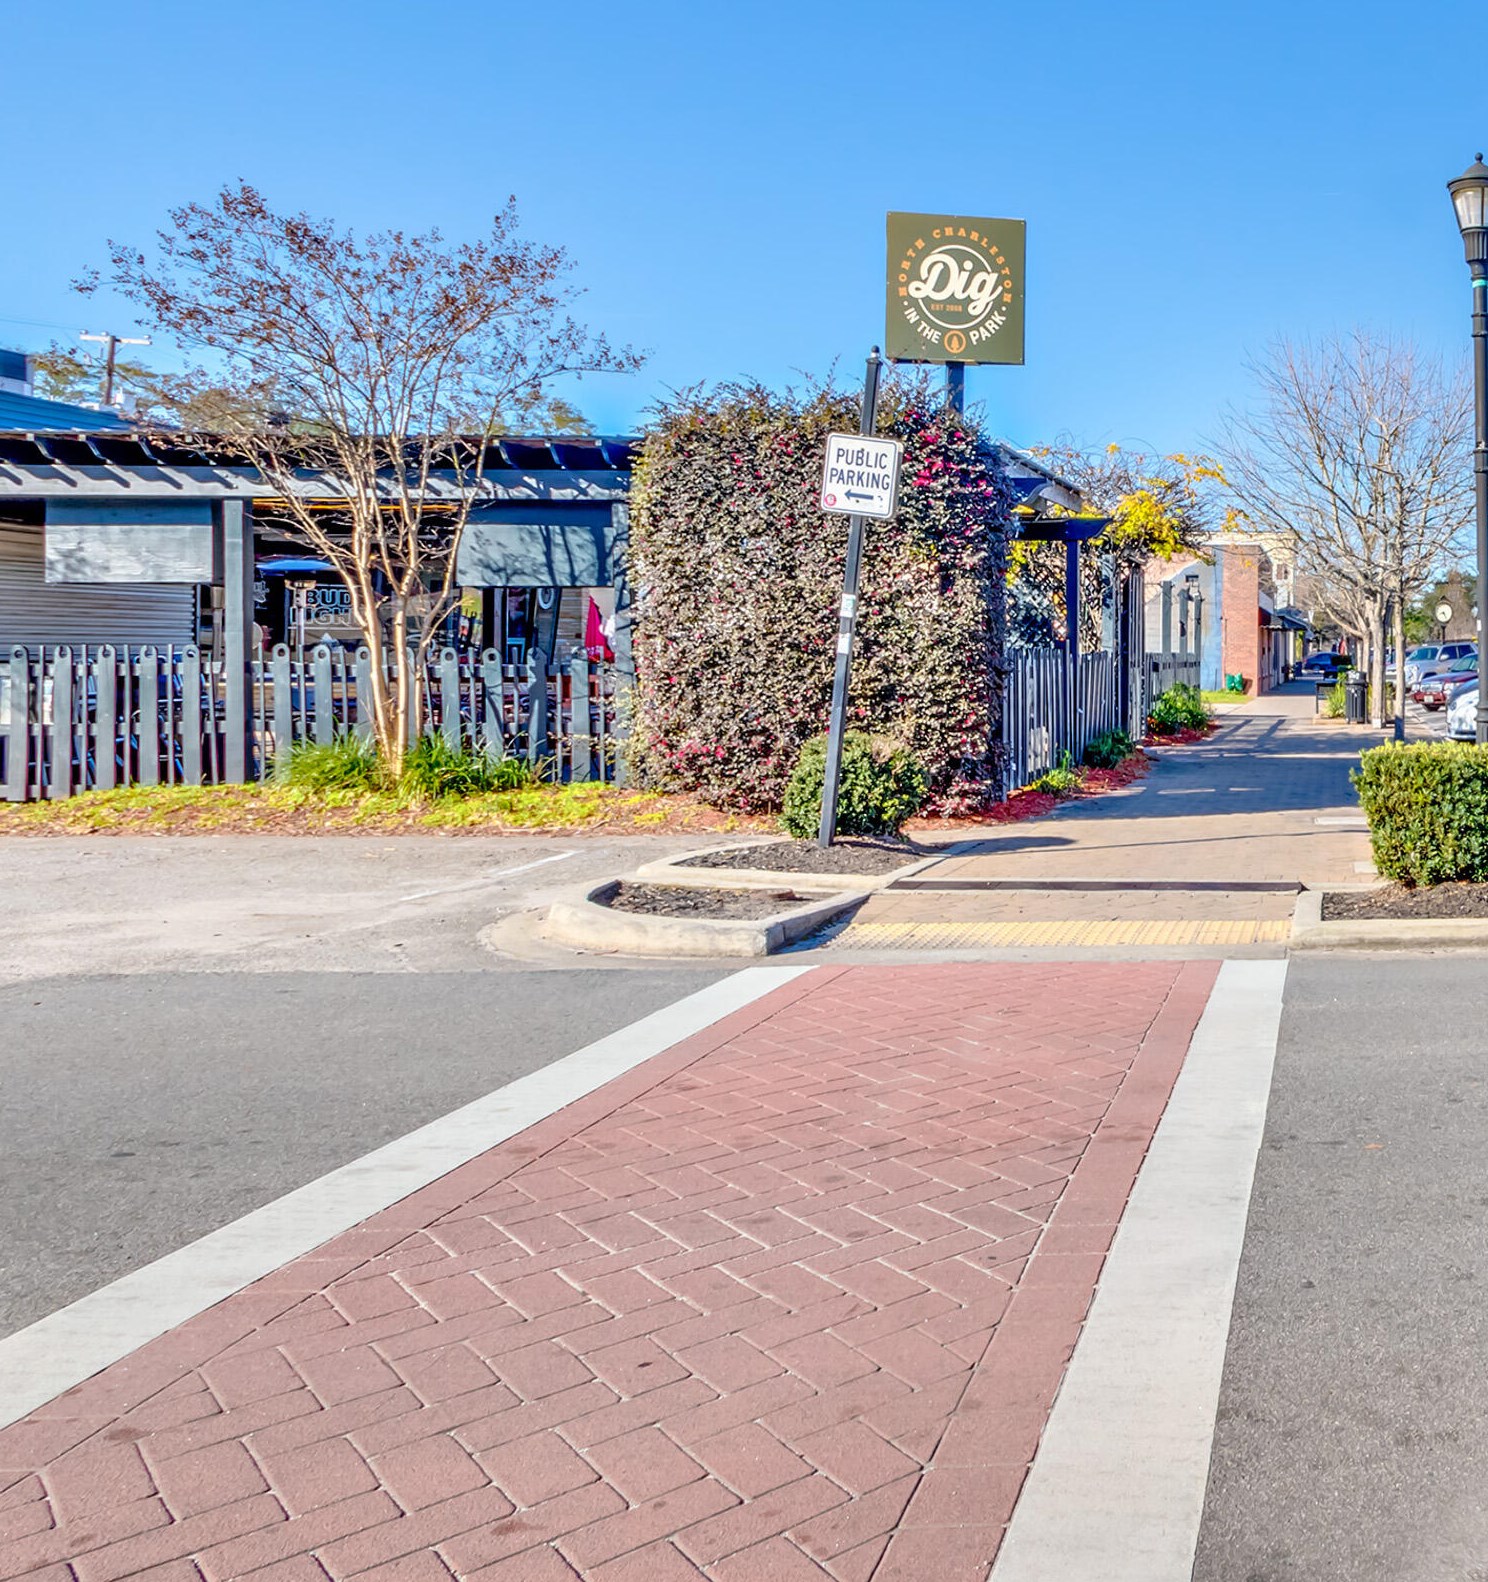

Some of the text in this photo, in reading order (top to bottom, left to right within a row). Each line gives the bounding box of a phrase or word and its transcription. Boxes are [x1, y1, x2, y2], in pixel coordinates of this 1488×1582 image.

[898, 227, 1012, 303] NORTH CHARLESTON
[908, 253, 1003, 316] Dig
[904, 308, 1007, 345] IN THE PARK
[836, 448, 888, 470] PUBLIC
[829, 467, 890, 491] PARKING
[305, 588, 352, 608] BUD
[290, 606, 354, 626] LIGH
